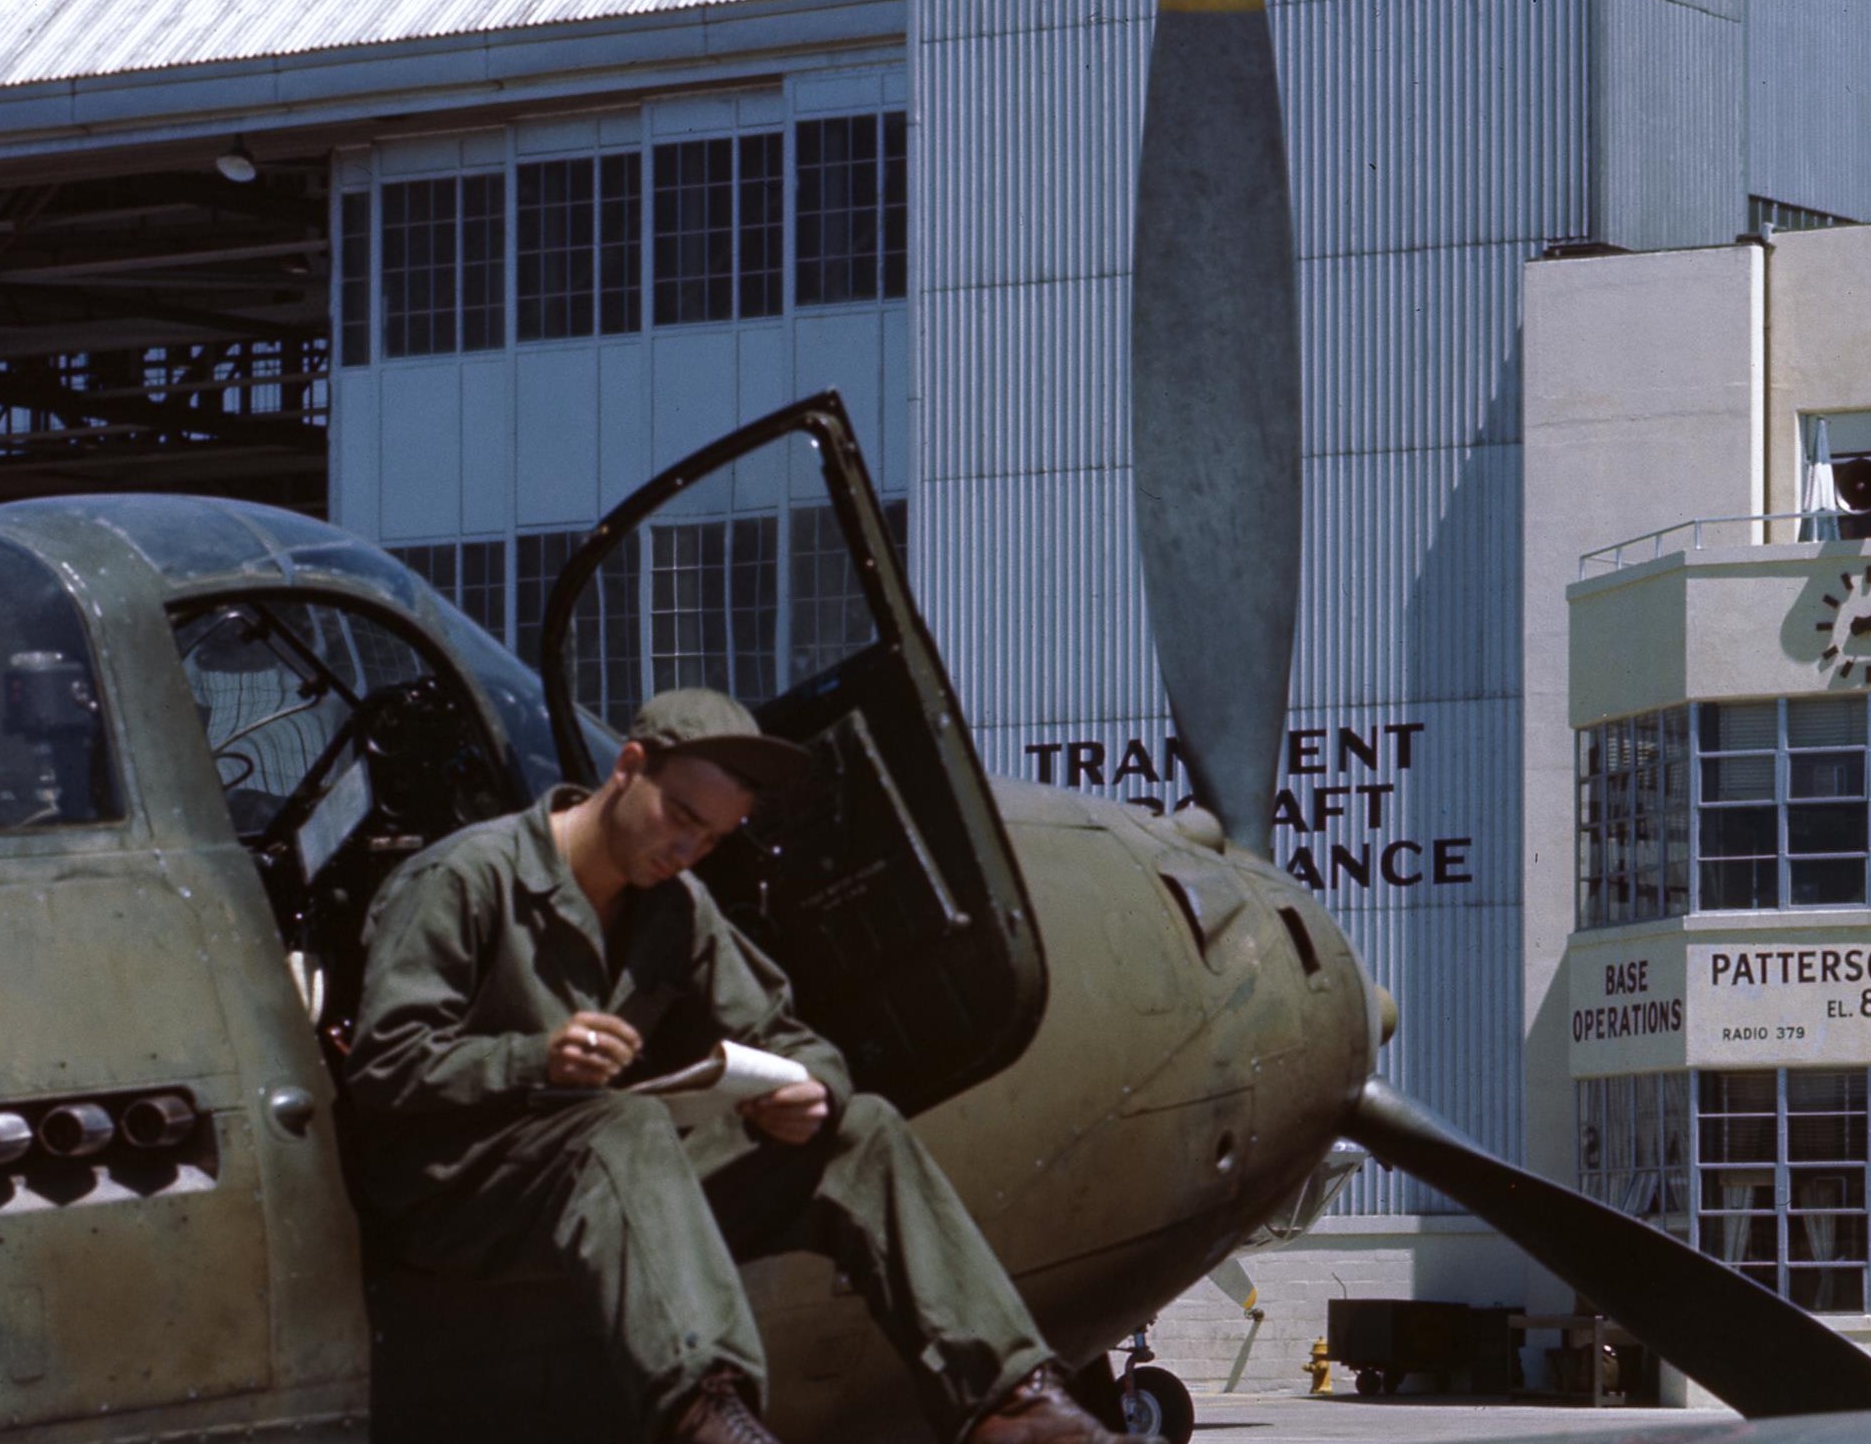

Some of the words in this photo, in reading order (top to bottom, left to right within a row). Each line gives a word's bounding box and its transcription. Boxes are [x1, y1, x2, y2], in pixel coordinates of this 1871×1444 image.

[1605, 959, 1648, 996] BASE
[1572, 998, 1683, 1044] OPERATIONS
[1827, 999, 1854, 1019] EL.
[1722, 1026, 1768, 1041] RADIO
[1776, 1026, 1806, 1040] 379
